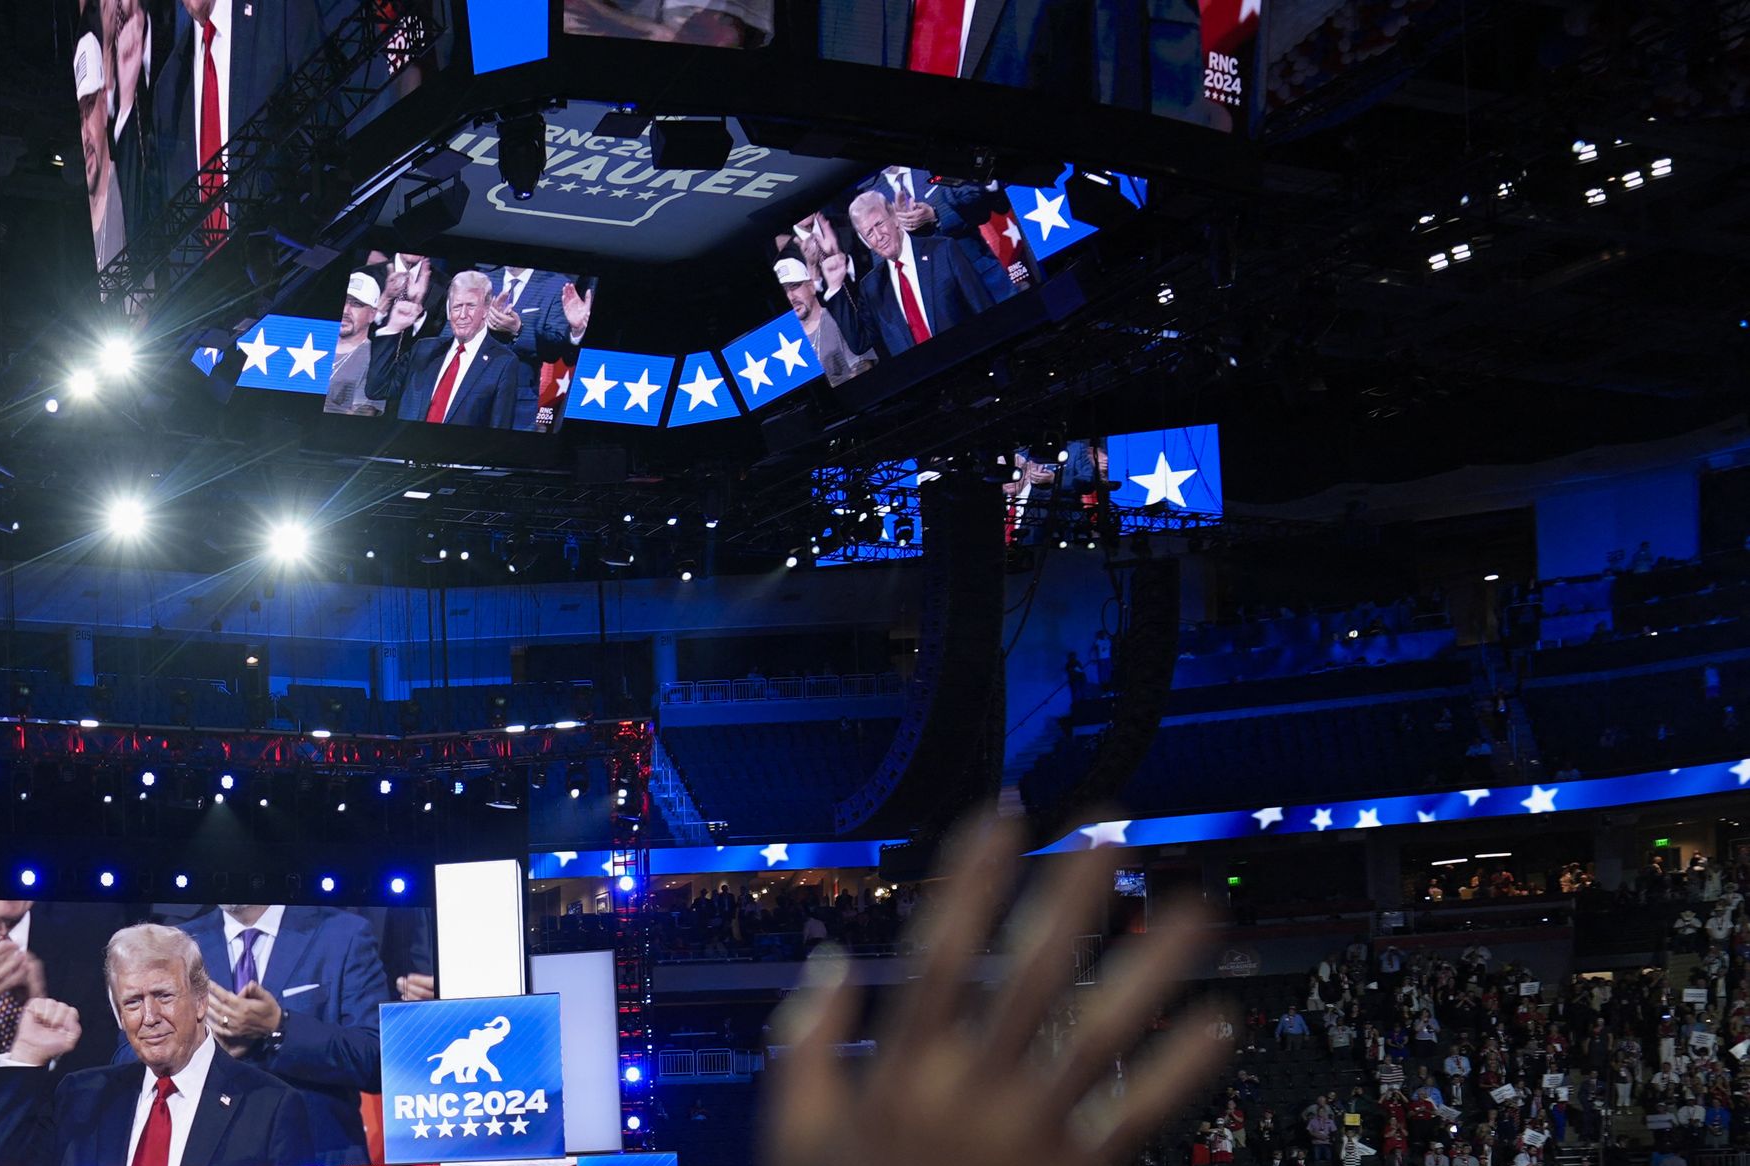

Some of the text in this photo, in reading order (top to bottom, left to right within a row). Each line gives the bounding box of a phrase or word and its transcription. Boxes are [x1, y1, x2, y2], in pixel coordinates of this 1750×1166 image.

[1208, 51, 1239, 75] RNC
[1203, 69, 1242, 95] 2024
[546, 124, 615, 151] RNC
[450, 133, 799, 199] ILAUKEE
[536, 413, 554, 421] 2024
[539, 406, 554, 414] RNC
[394, 1089, 549, 1120] RNC 2024
